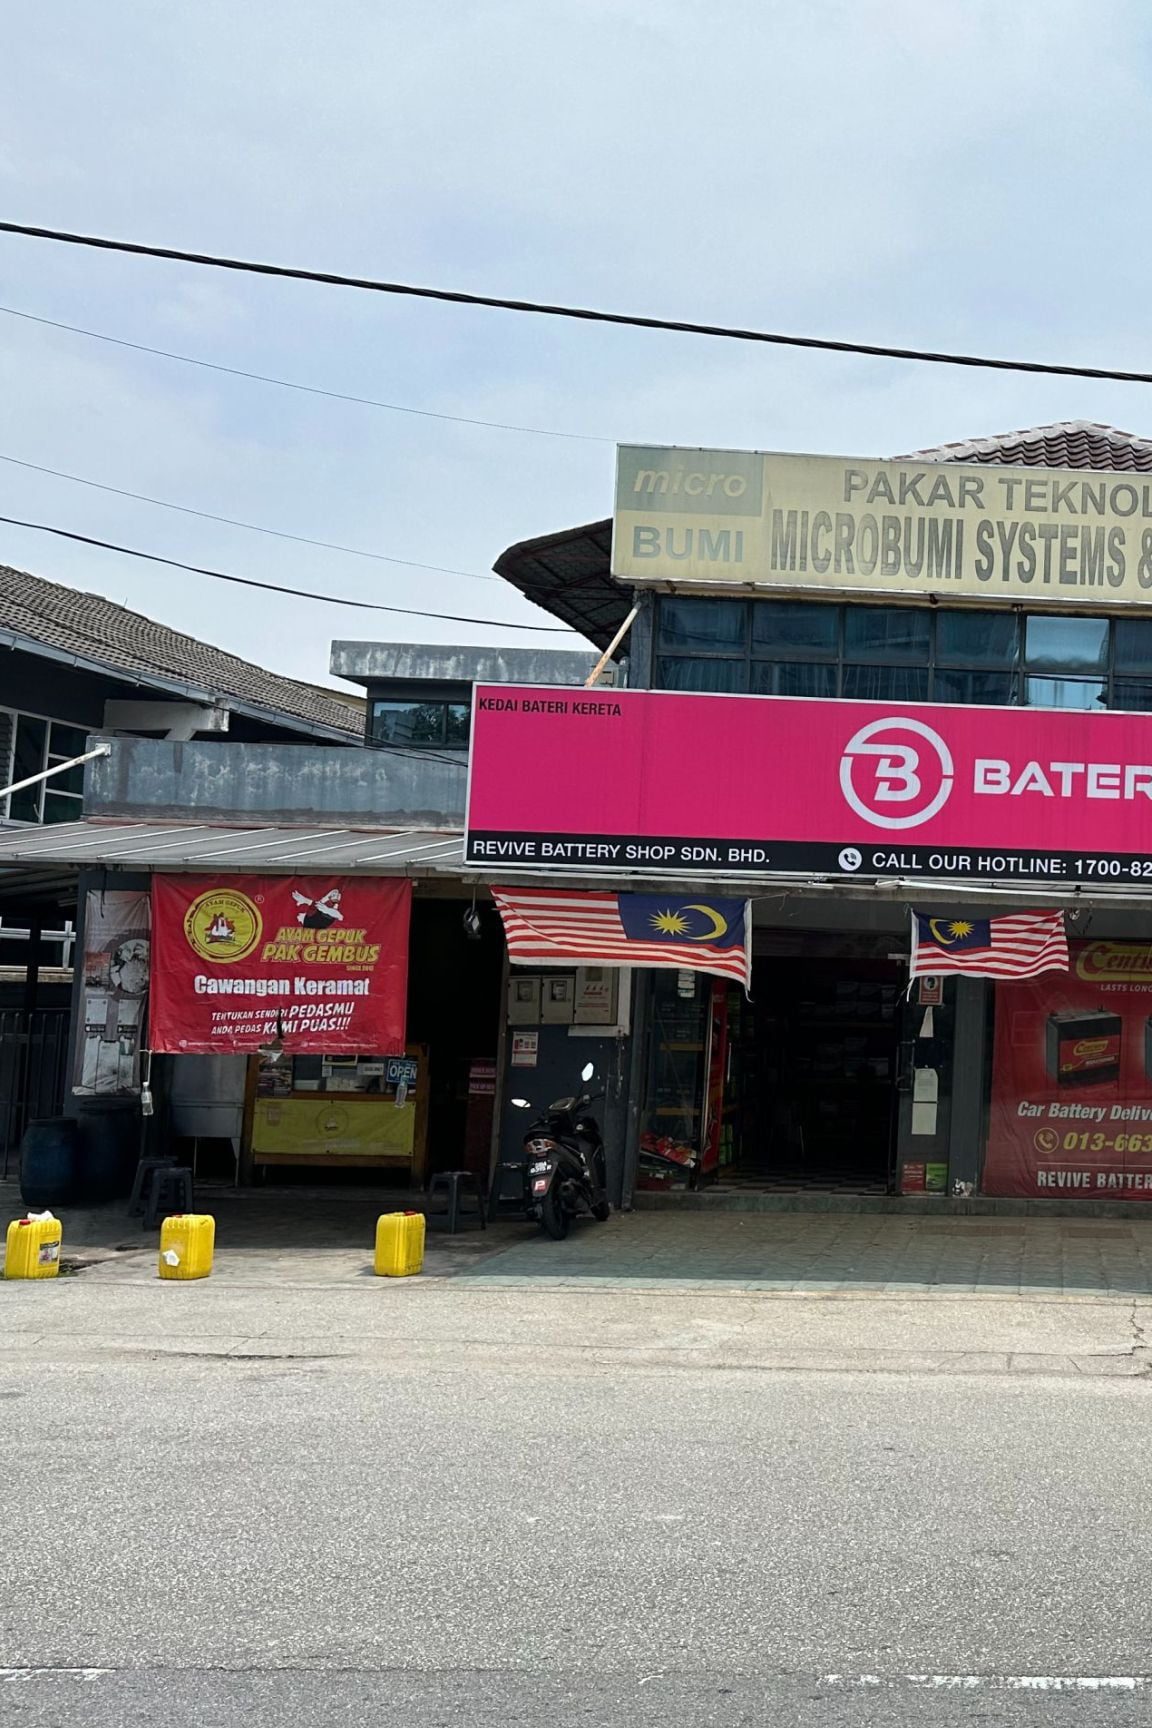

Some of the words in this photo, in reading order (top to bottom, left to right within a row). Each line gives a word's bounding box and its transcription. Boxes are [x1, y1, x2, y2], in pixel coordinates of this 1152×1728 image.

[633, 463, 748, 498] micro
[843, 469, 985, 510] PAKAR
[632, 525, 744, 563] BUMI
[770, 508, 965, 581] MICROBUMI
[974, 518, 1126, 588] SYSTEMS
[478, 697, 518, 712] KEDAI
[522, 700, 568, 714] BATERI
[572, 701, 622, 717] KERETA
[473, 840, 535, 857] REVIVE
[541, 842, 621, 859] BATTERY
[625, 845, 675, 860] SHOP
[680, 846, 722, 862] SDN.
[728, 848, 770, 863] BHD.
[872, 852, 922, 869] CALL
[929, 853, 971, 871] OUR
[977, 855, 1067, 874] HOTLINE:
[275, 927, 315, 943] AYAM
[316, 928, 367, 943] GEPUK
[261, 942, 303, 963] PAK
[303, 944, 381, 965] GEMBUS
[194, 975, 291, 997] Cawangan
[294, 976, 370, 996] Keramat
[1100, 984, 1126, 992] LASTS
[212, 1011, 252, 1021] TENTUKAN
[289, 1002, 354, 1018] PEDASMU
[211, 1026, 233, 1035] ANDA
[235, 1024, 261, 1034] PEDAS
[262, 1021, 298, 1035] KAMI
[300, 1017, 351, 1032] PUAS!!!
[390, 1065, 418, 1079] OPEN
[1018, 1101, 1045, 1118] Car
[1048, 1103, 1105, 1122] Battery
[1037, 1171, 1091, 1188] REVIVE
